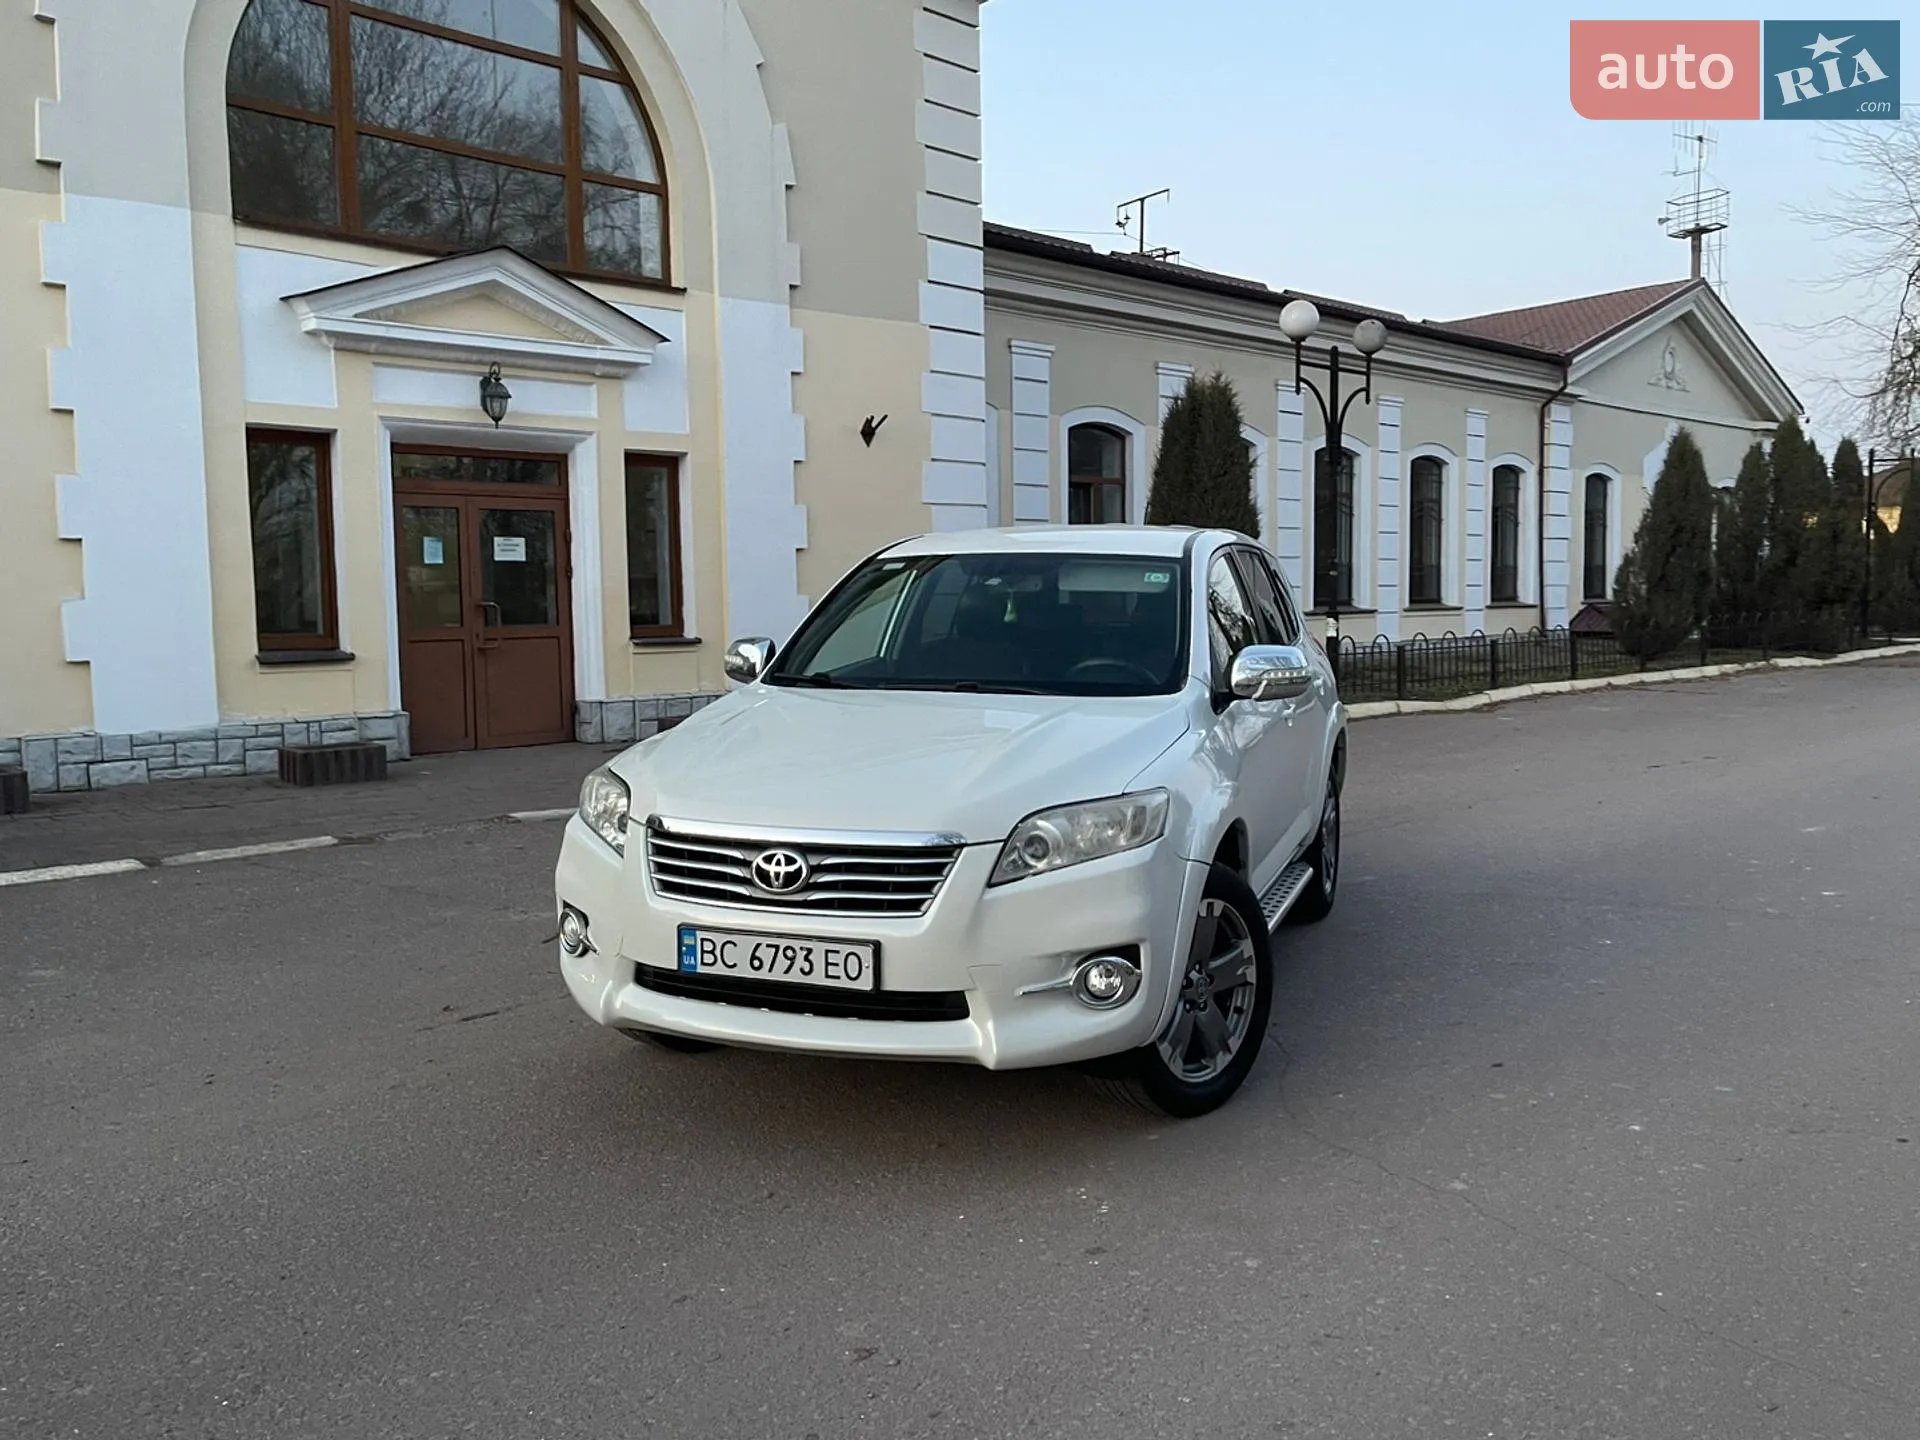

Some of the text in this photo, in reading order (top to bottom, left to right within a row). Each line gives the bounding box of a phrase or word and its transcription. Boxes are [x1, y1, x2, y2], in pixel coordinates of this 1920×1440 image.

[682, 956, 696, 966] UA
[699, 937, 863, 981] BC 6793 EO
